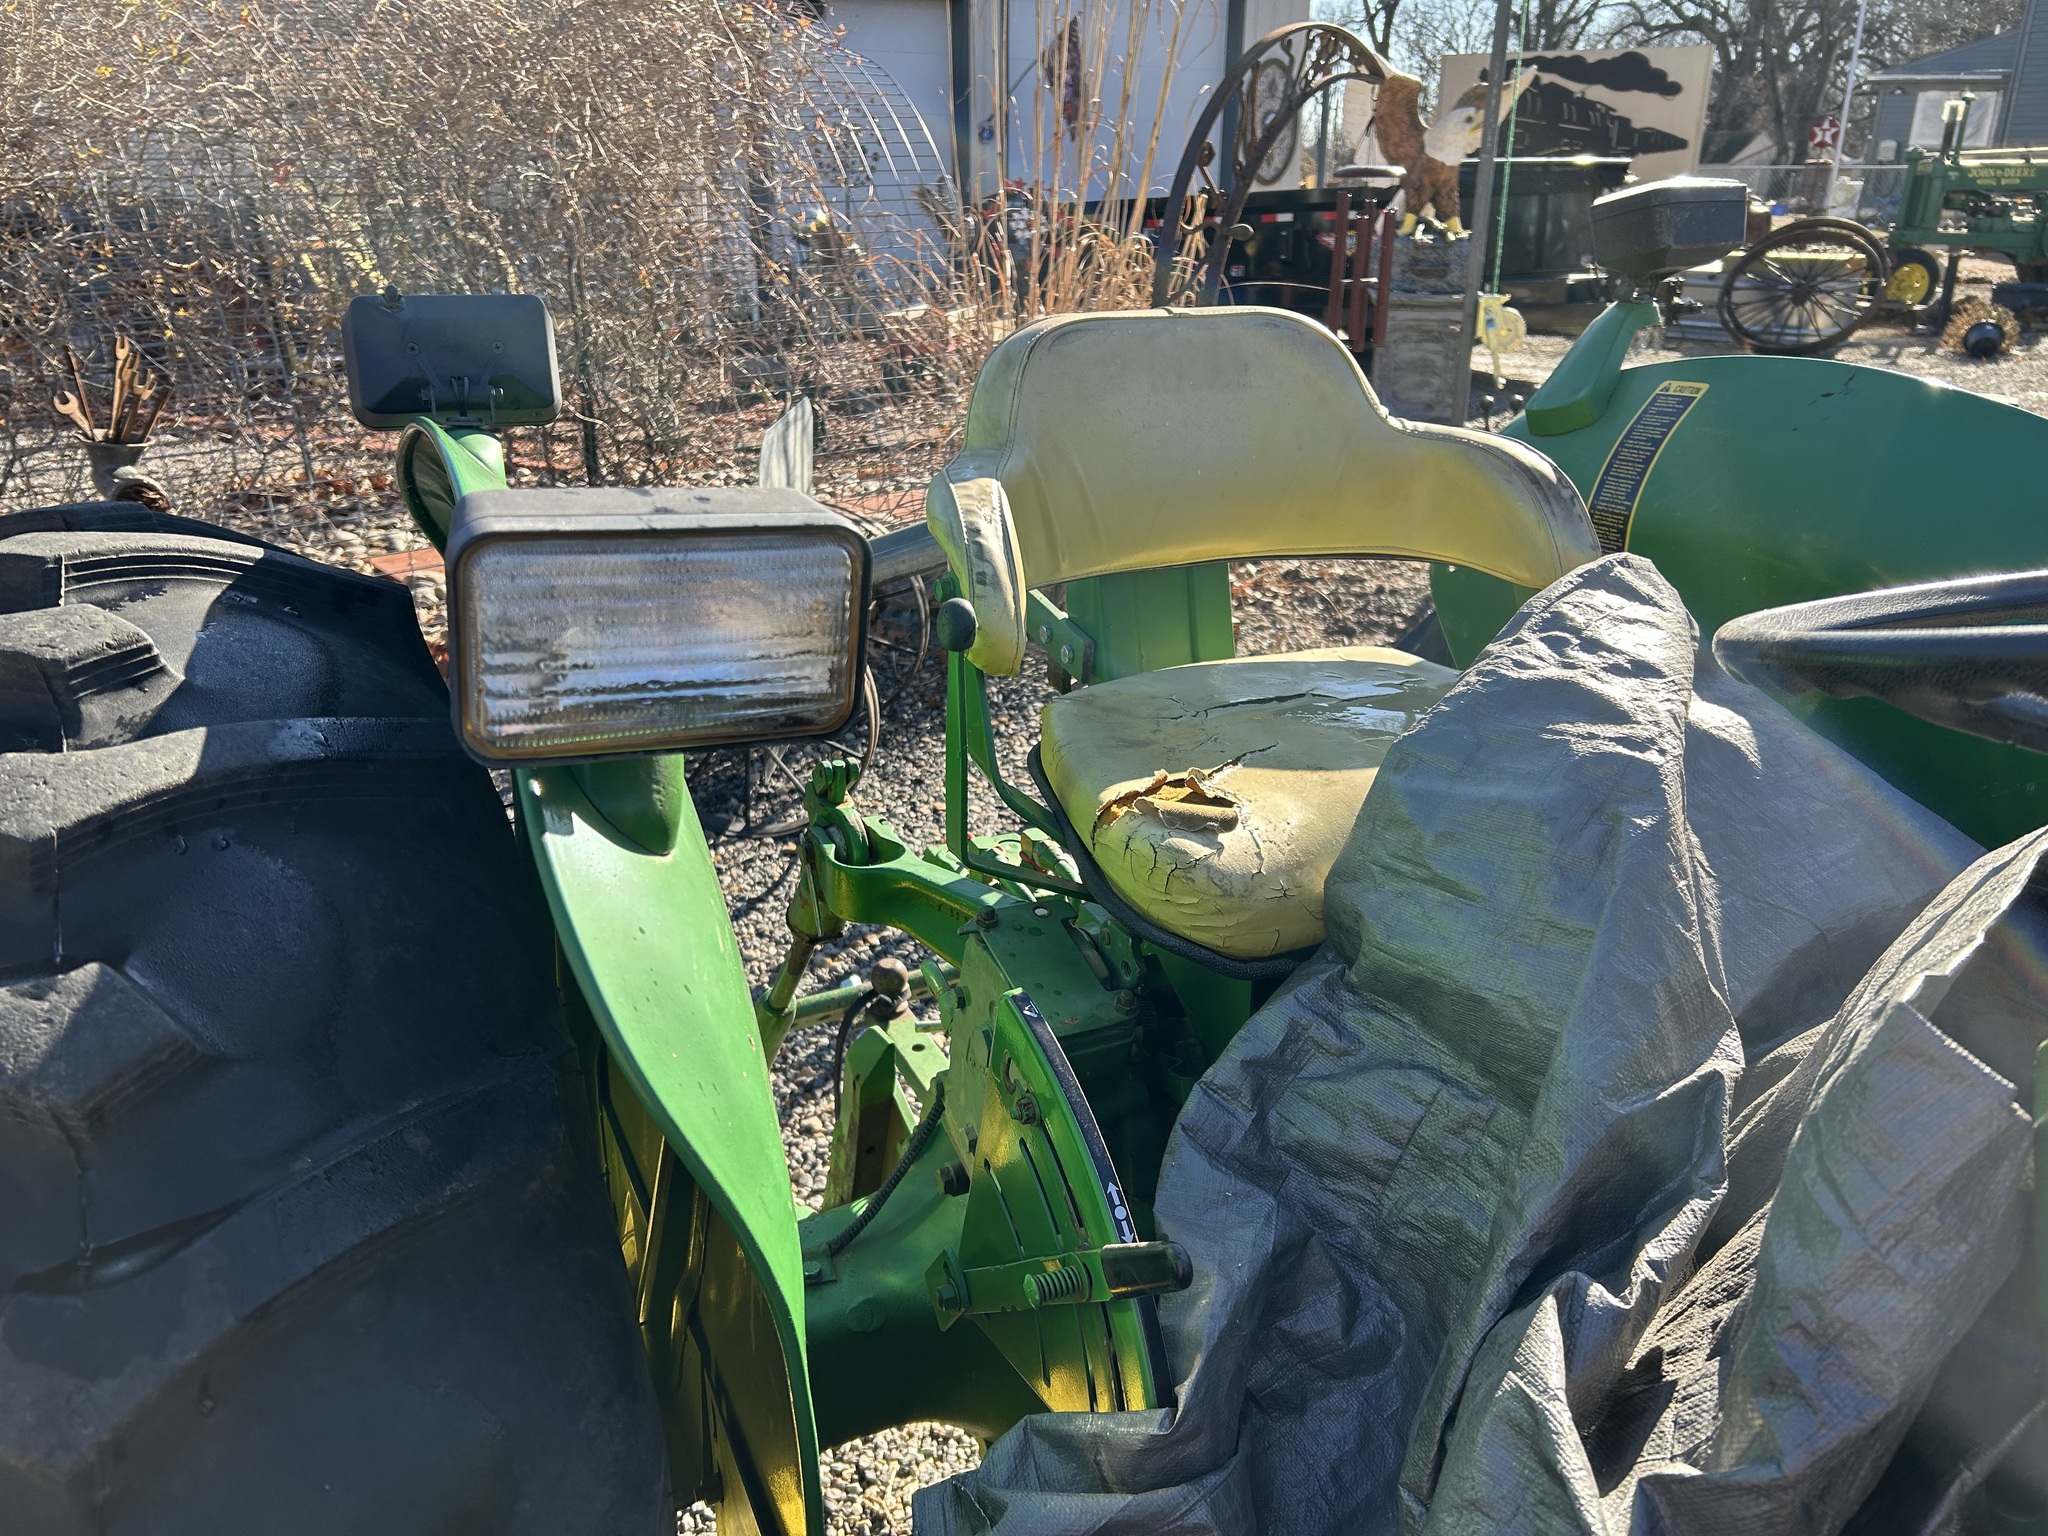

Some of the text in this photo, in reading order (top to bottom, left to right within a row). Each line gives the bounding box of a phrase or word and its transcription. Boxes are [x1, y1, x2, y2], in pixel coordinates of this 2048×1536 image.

[1967, 167, 1995, 177] JOHN
[2003, 167, 2037, 177] DEERE
[1672, 385, 1702, 395] CAUTION
